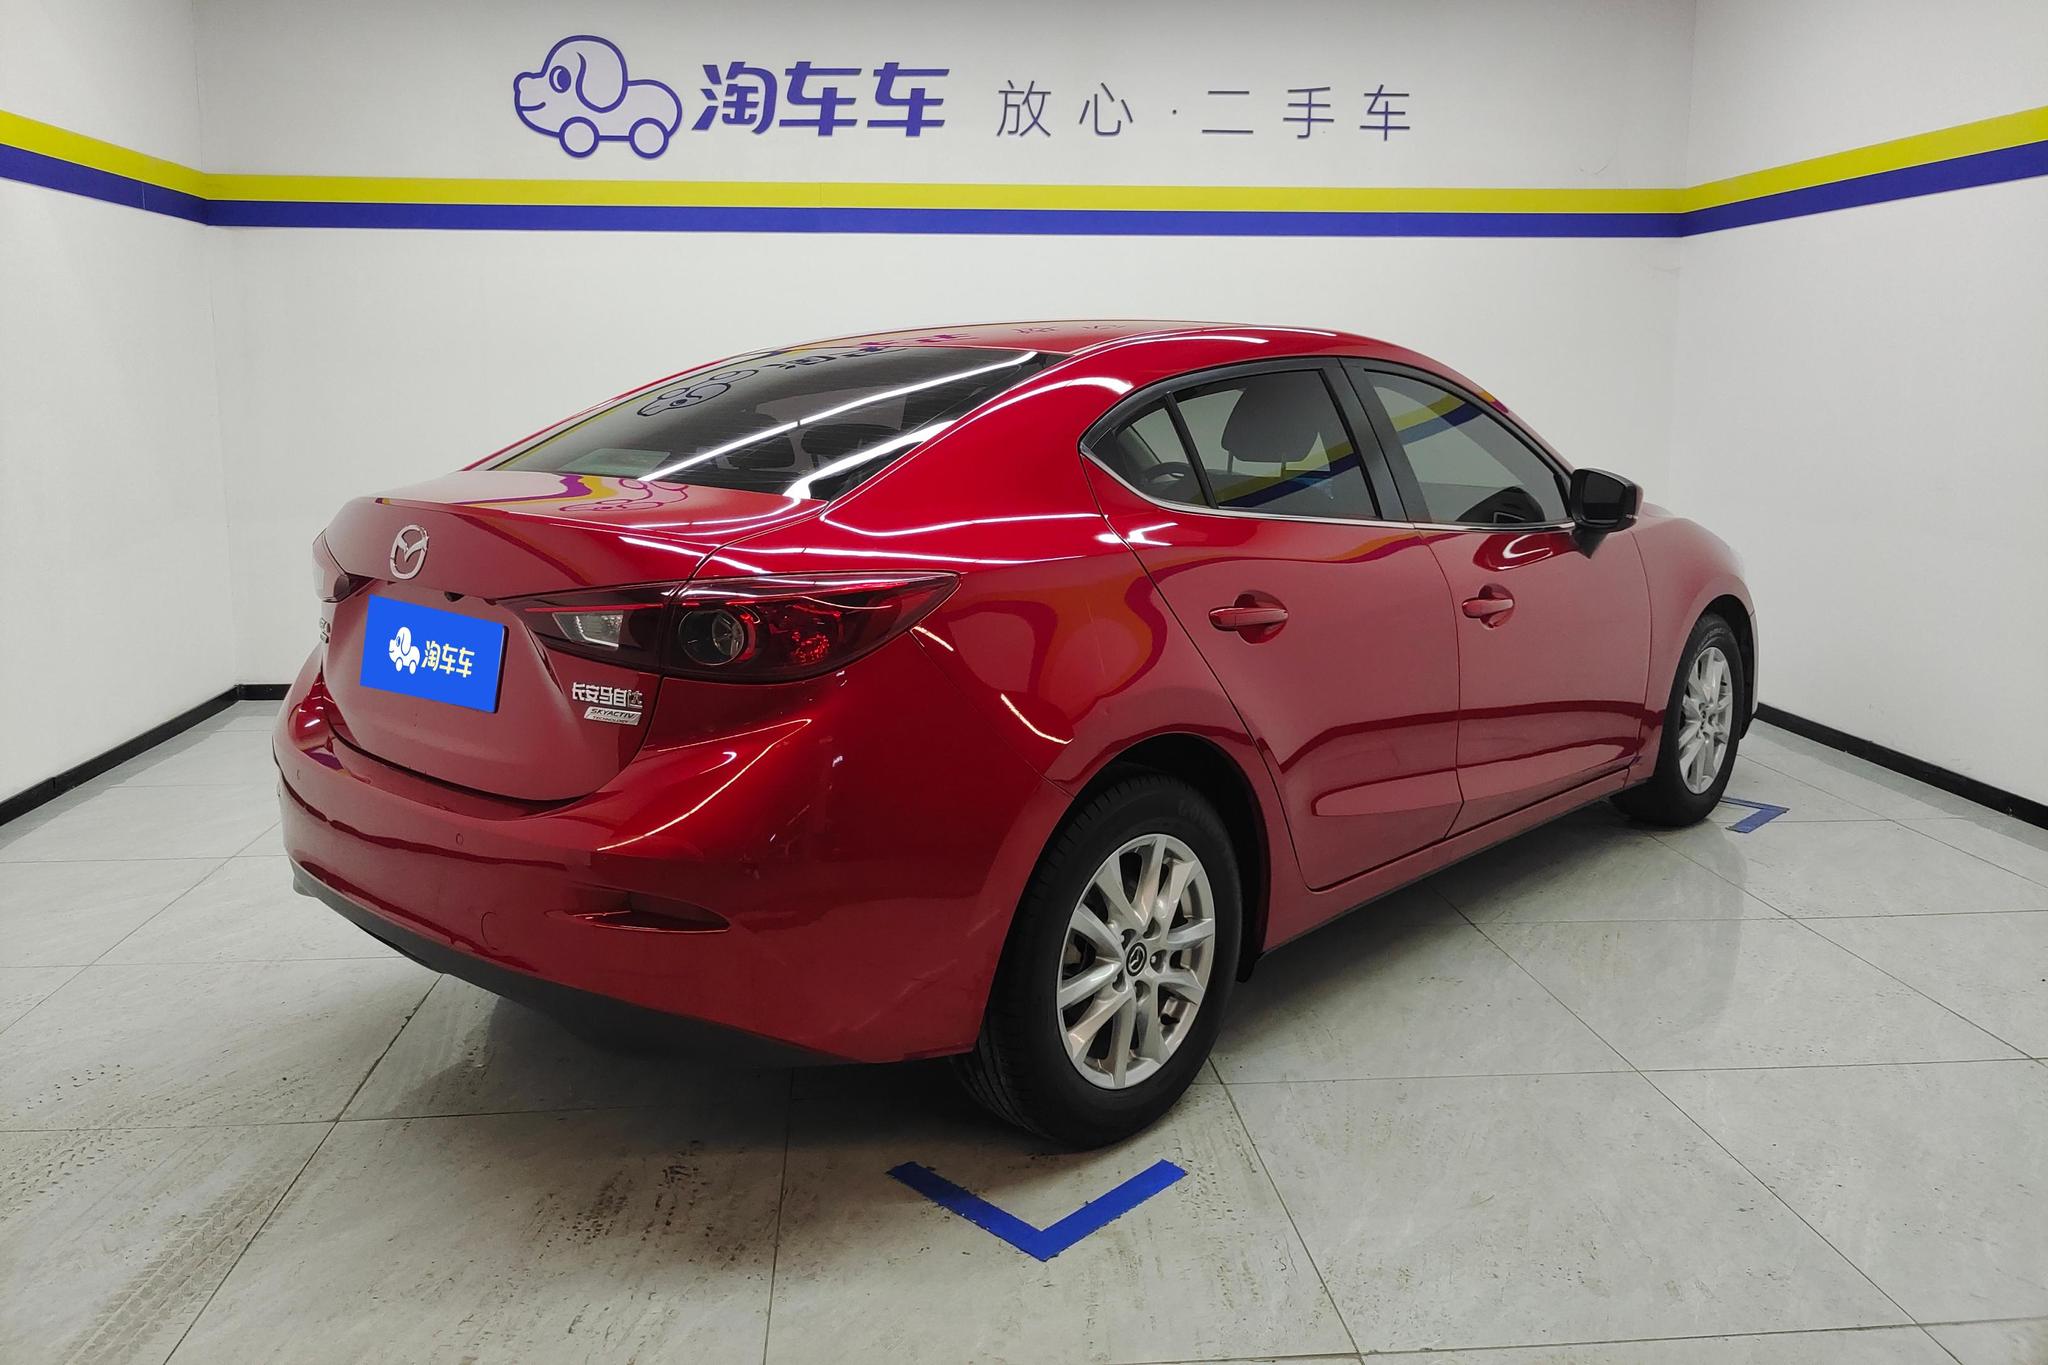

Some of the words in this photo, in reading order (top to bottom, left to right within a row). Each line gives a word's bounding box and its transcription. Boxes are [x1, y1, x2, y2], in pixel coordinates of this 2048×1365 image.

[691, 61, 950, 137] 淘车车
[590, 708, 635, 719] SKYACTIV
